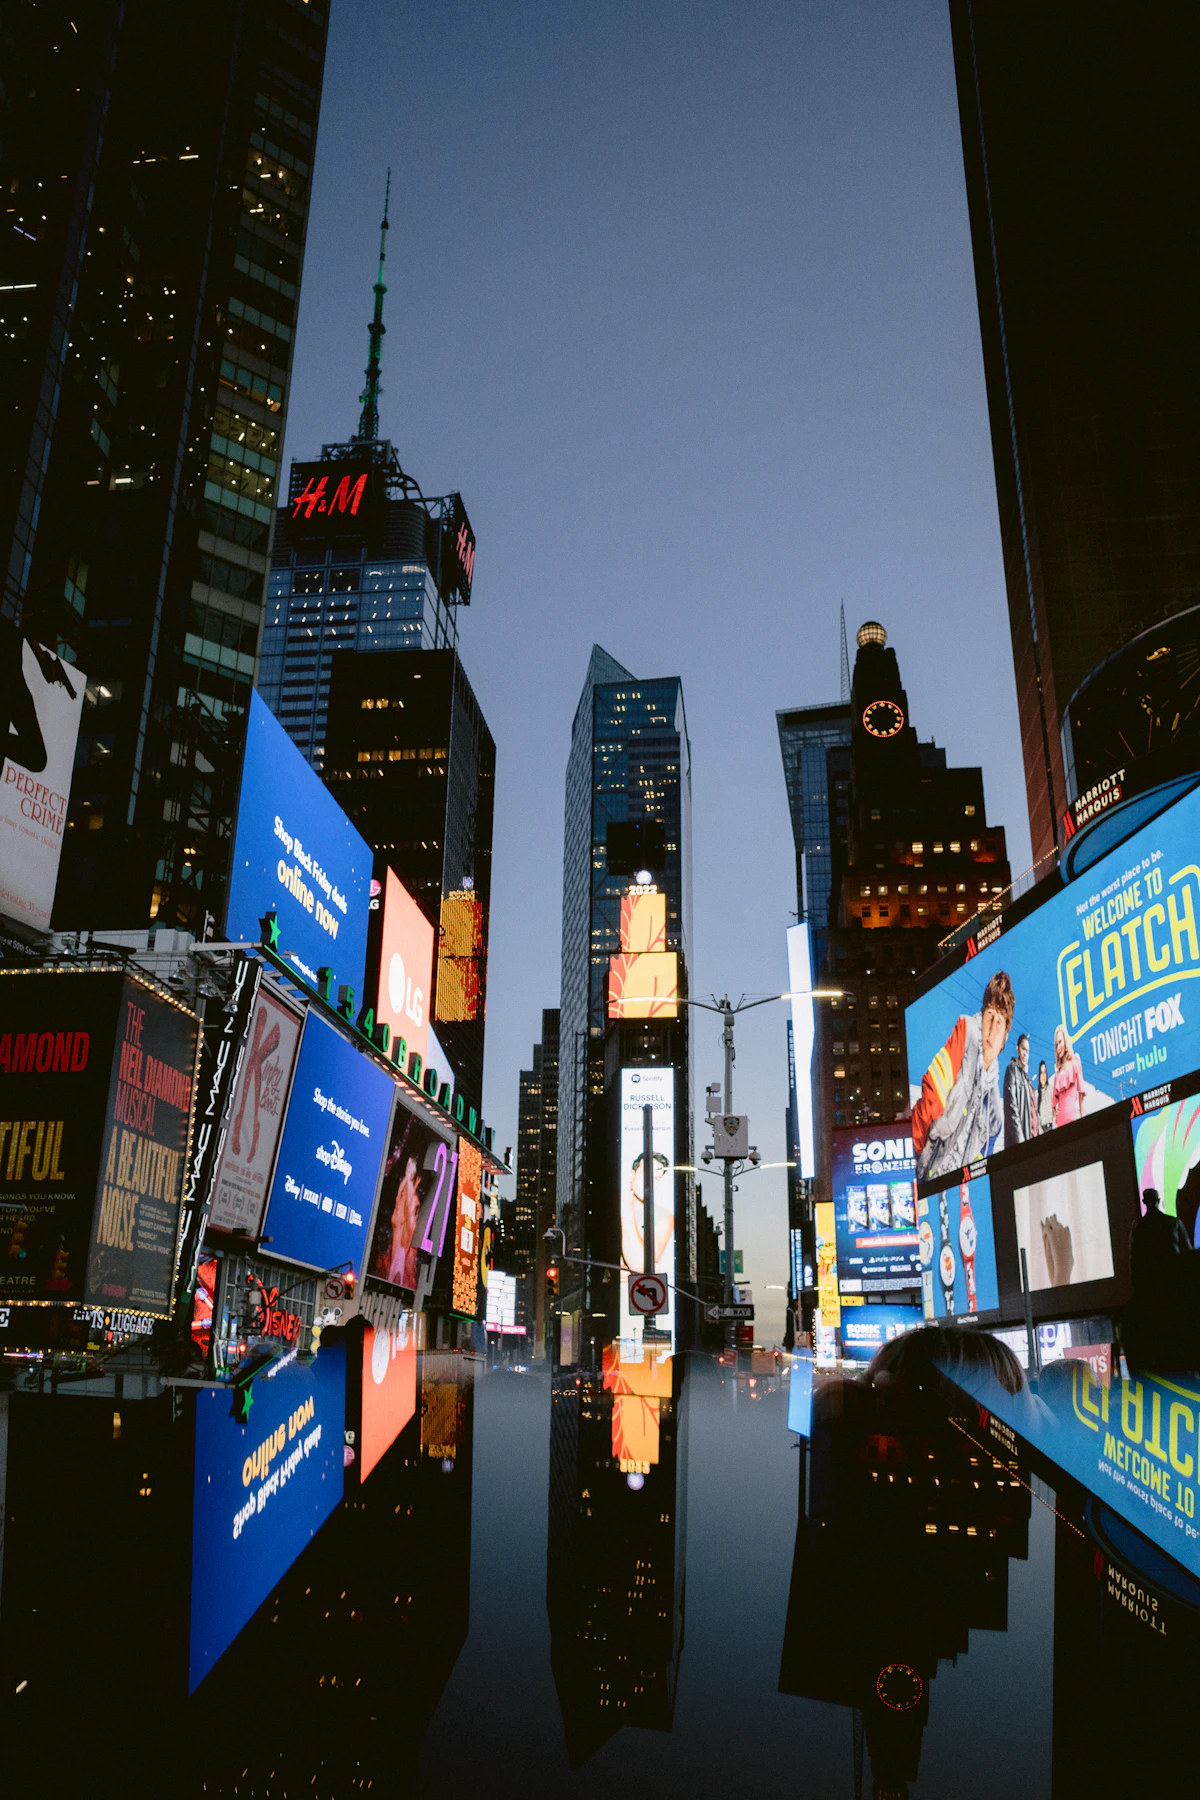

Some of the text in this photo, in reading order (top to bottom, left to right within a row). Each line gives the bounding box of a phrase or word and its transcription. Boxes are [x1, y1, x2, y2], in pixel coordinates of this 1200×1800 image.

[292, 474, 368, 518] H&M
[456, 522, 475, 585] H&M
[5, 765, 67, 815] PERFECT
[1075, 769, 1126, 813] MARRIOTT
[1076, 787, 1121, 827] MARQUIS
[20, 797, 64, 836] CRIME
[274, 815, 348, 915] Shop Black Friday deals
[1075, 850, 1164, 916] Not the worst place to be.
[277, 859, 339, 940] online now
[1081, 867, 1163, 941] WELCOME TO
[976, 914, 1003, 940] MARRIOTT
[977, 927, 1001, 951] MARQUIS
[1065, 884, 1200, 1028] FLATCH
[126, 1001, 146, 1048] THE
[405, 976, 423, 1027] LG
[1090, 992, 1185, 1065] TONIGHT FOX
[0, 1032, 91, 1073] AMOND
[1112, 1044, 1168, 1078] NEXT DAY hulu
[119, 1041, 192, 1113] NEIL DIAMOND
[204, 1040, 231, 1116] MAC
[395, 1036, 496, 1146] BROADWAY
[630, 1094, 665, 1102] RUSSELL
[1143, 1083, 1172, 1103] MARRIOTT
[114, 1080, 157, 1136] MUSICAL
[313, 1087, 328, 1113] Shop
[326, 1097, 337, 1115] the
[1143, 1094, 1170, 1112] MARQUIS
[105, 1125, 179, 1205] A BEAUTIFUL
[185, 1123, 213, 1202] MAC
[25, 1205, 56, 1213] YOU'VE
[96, 1184, 140, 1252] NOISE
[110, 1312, 155, 1335] LUGGAGE
[712, 1306, 748, 1316] ONE WAY
[846, 1323, 881, 1334] SONIC
